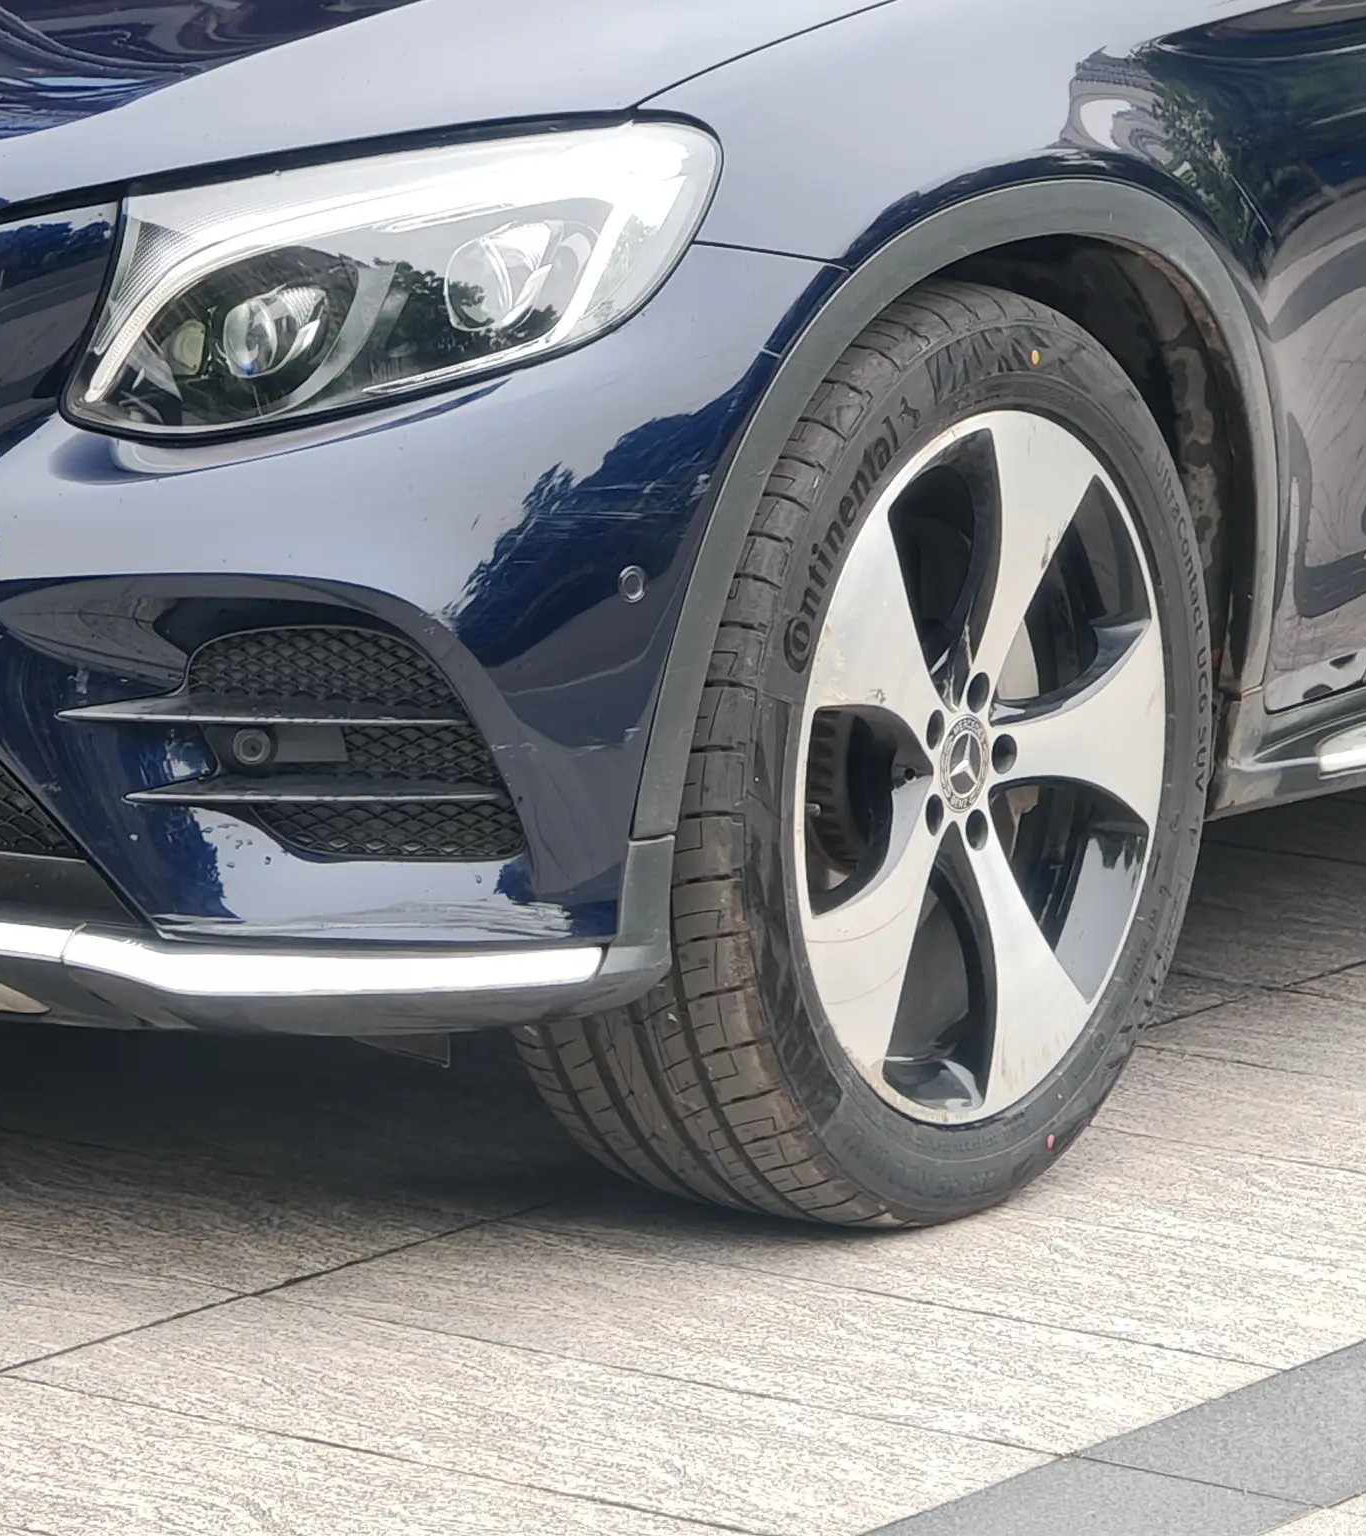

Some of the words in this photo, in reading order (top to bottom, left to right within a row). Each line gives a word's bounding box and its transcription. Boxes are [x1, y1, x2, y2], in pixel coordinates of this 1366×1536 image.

[785, 415, 902, 674] Continental
[1154, 449, 1205, 635] UltraContact
[1196, 646, 1210, 715] UCG
[1194, 724, 1210, 794] SUV
